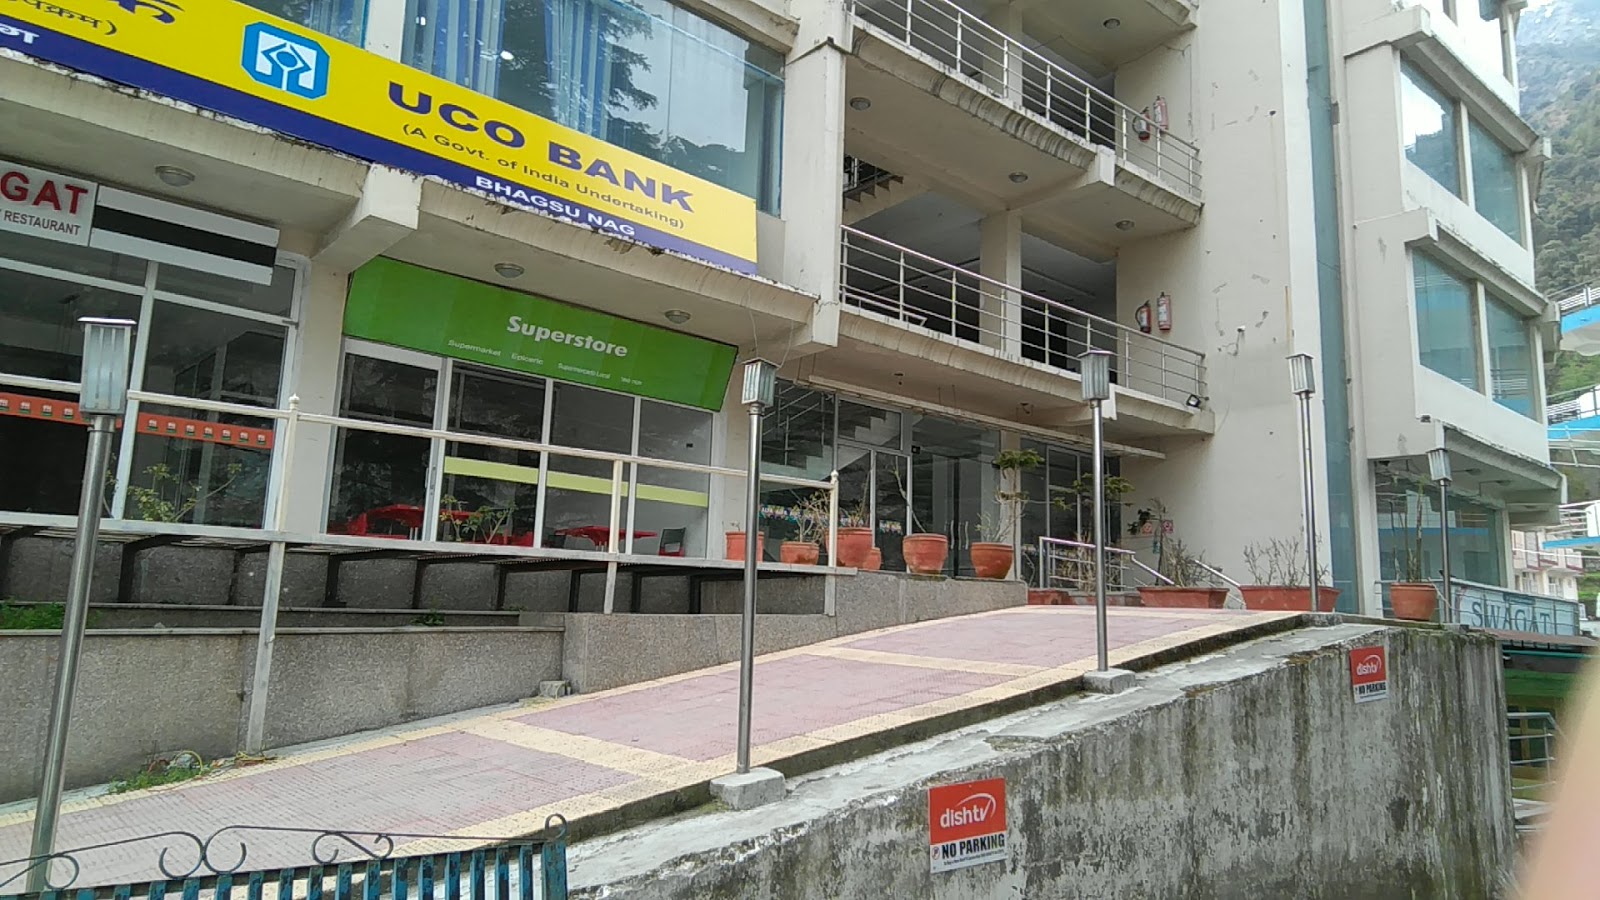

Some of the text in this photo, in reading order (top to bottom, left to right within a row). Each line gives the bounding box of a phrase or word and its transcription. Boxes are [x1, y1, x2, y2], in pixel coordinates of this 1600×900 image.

[388, 81, 694, 213] UCO BANK
[403, 124, 685, 230] (A Govt. of India Undertaking)
[475, 175, 635, 236] BHAGSU NAG
[4, 210, 80, 236] RESTAURANT
[448, 339, 502, 357] Supermarket
[506, 315, 628, 357] Superstore
[1471, 601, 1551, 635] SWAGAT
[1356, 659, 1380, 676] dishtv
[1366, 682, 1387, 693] PARKING
[940, 798, 992, 829] dishtv
[941, 843, 957, 859] NO
[960, 833, 1005, 856] PARKING
